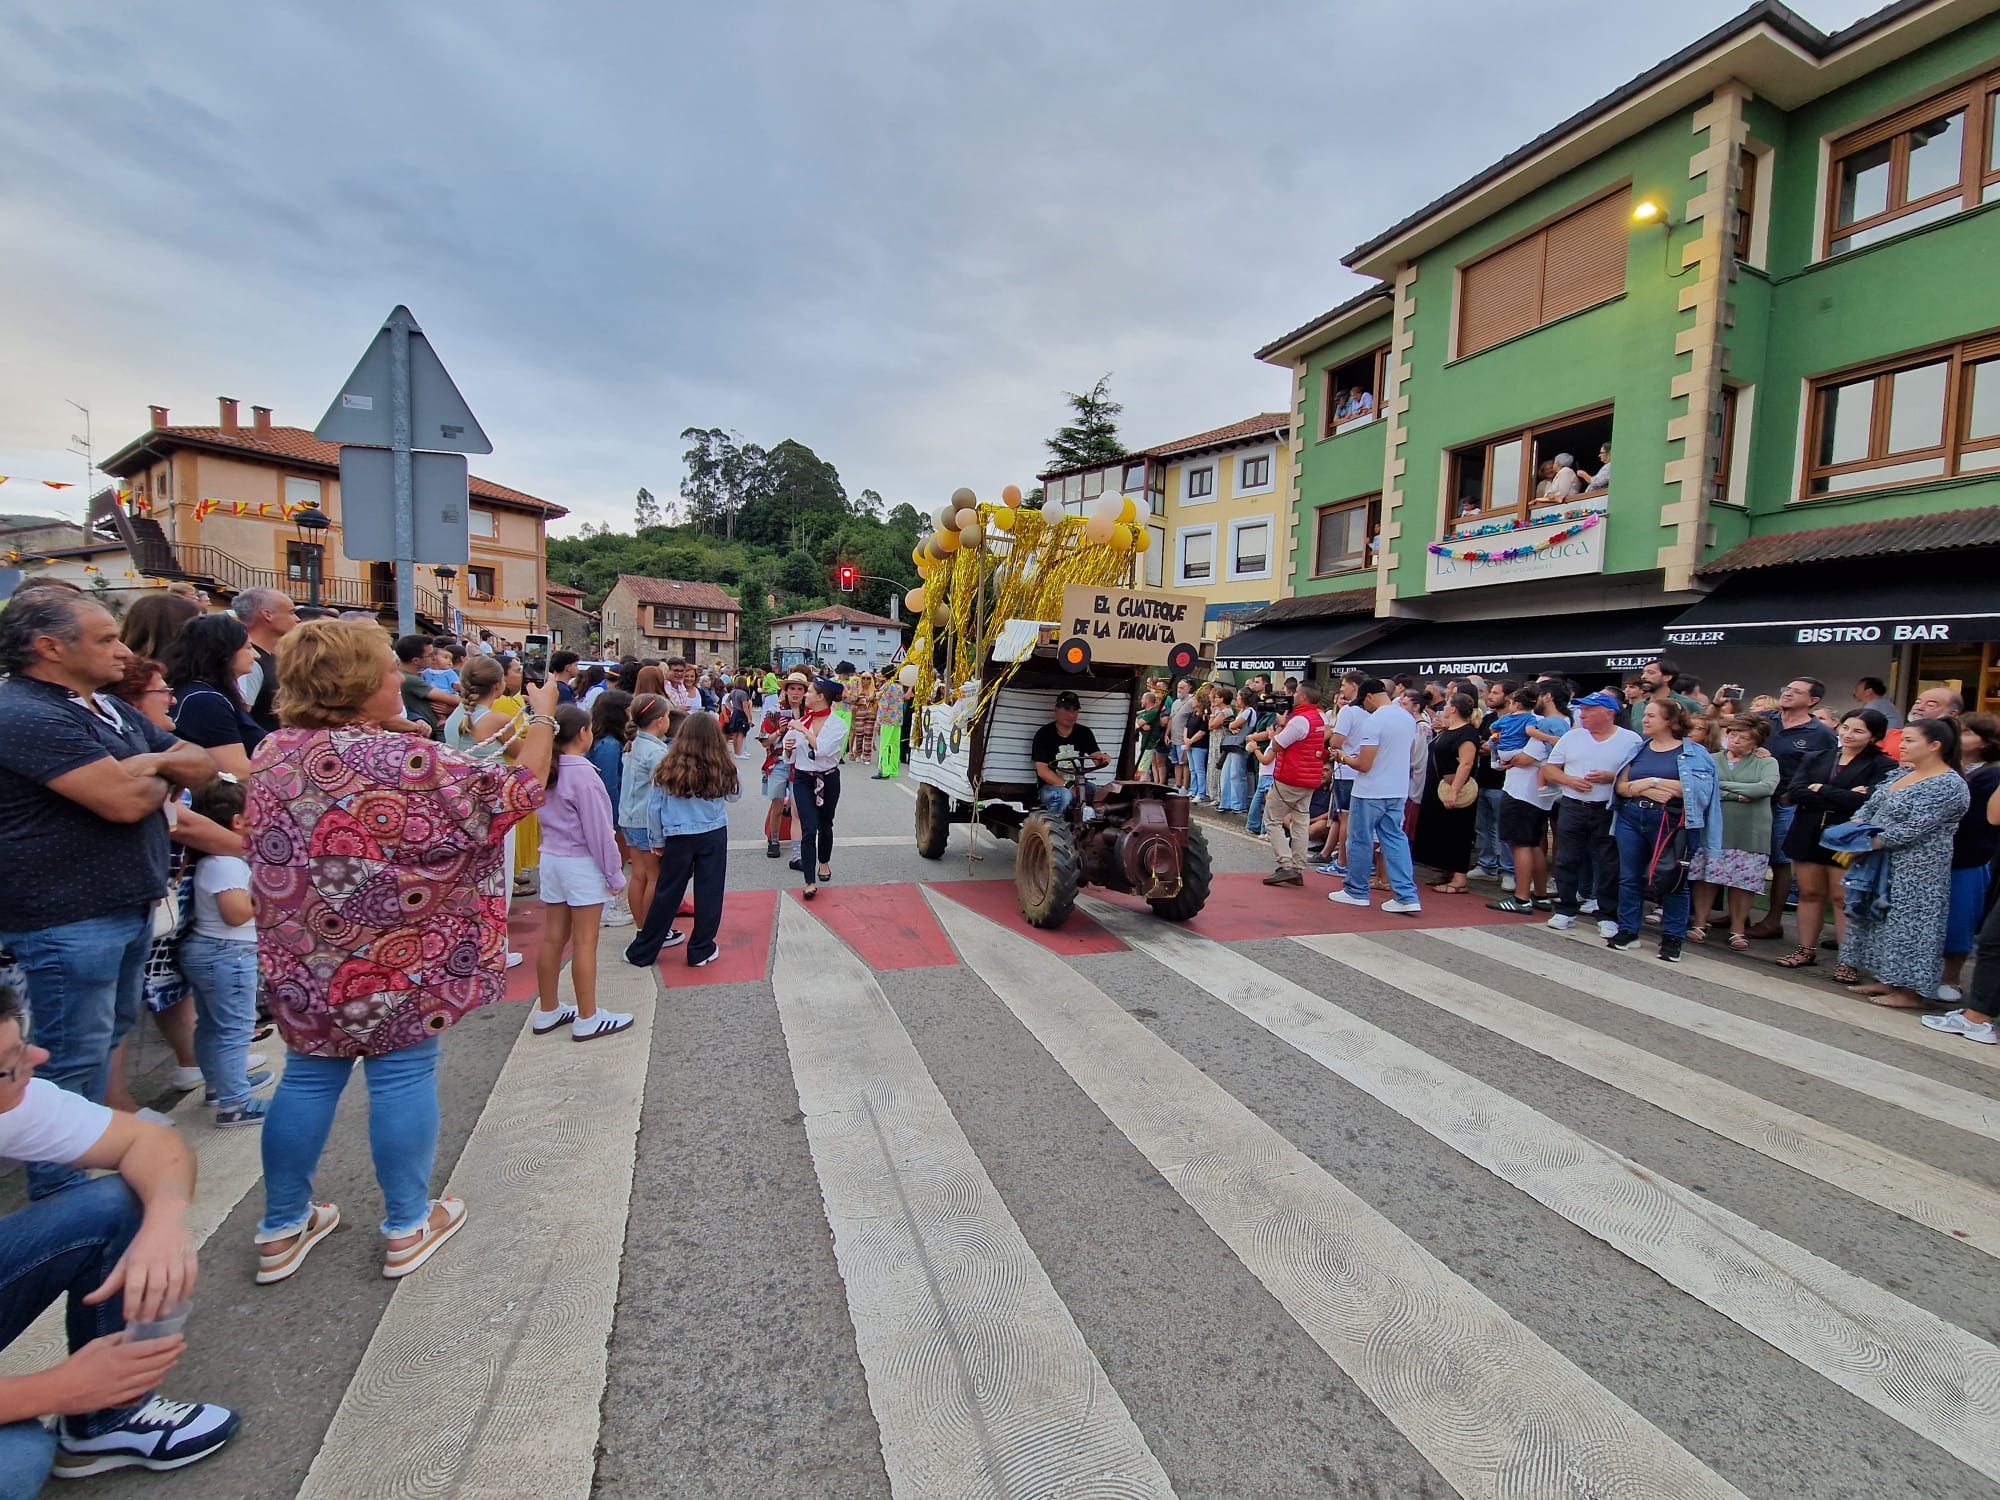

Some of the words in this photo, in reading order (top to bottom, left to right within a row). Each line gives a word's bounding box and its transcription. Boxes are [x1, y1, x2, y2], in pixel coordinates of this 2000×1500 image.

[1094, 595, 1110, 614] EL
[1116, 597, 1187, 622] GUATEQUE
[1073, 618, 1090, 636] DE
[1093, 620, 1110, 638] LA
[1666, 631, 1725, 641] KELER
[1797, 626, 1881, 643] BISTRO
[1893, 624, 1949, 641] BAR
[1229, 661, 1239, 670] DE
[1241, 661, 1275, 670] MERCADO
[1419, 664, 1433, 675] LA
[1439, 662, 1509, 674] PARIENTUCA
